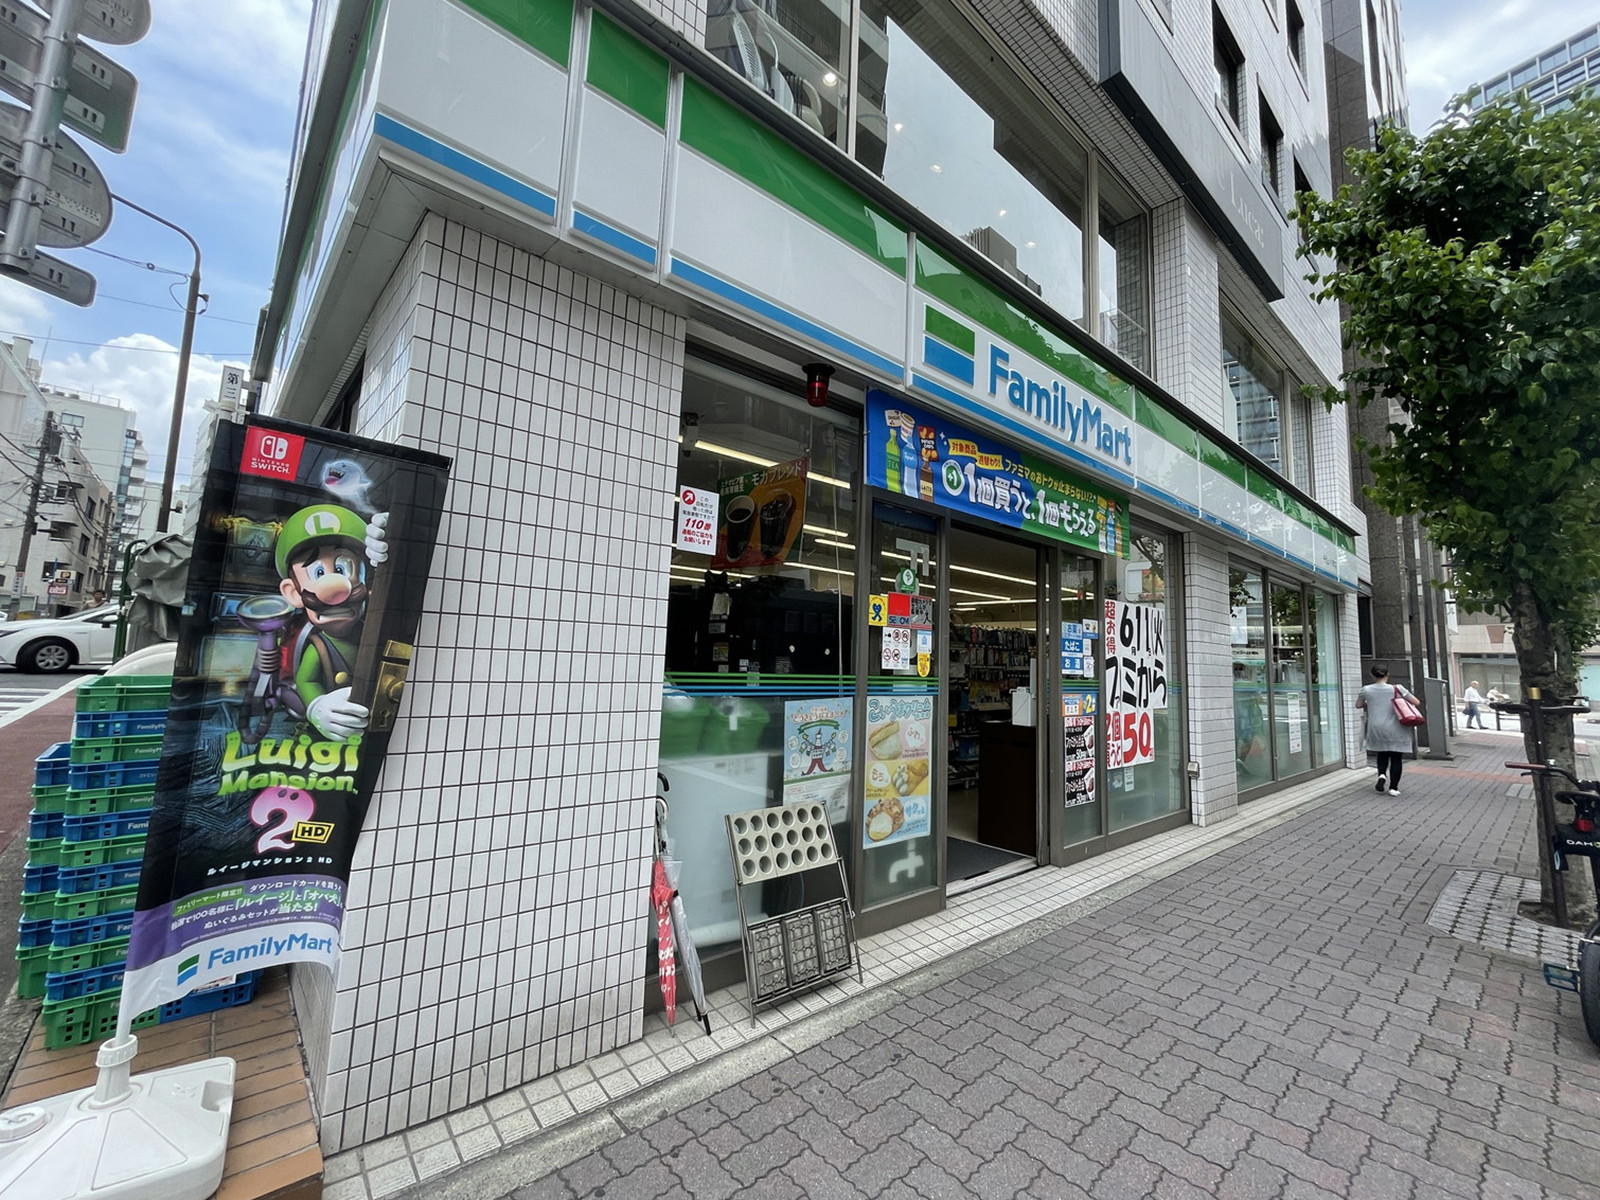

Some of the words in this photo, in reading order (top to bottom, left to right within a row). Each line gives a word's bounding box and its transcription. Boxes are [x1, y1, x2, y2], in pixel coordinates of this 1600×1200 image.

[988, 342, 1132, 465] FamilyMart
[250, 461, 289, 474] SWITCH
[251, 457, 290, 468] NINTENDO
[751, 462, 802, 486] モカブレンド
[887, 460, 900, 469] TEA
[685, 517, 712, 531] 110番
[1105, 601, 1116, 655] 超お得
[1064, 641, 1080, 652] たばこ
[221, 730, 363, 773] Luigi
[217, 770, 355, 796] Mansion
[250, 785, 316, 854] 2
[301, 826, 326, 838] HD
[207, 856, 313, 876] ルイージマンション2
[318, 856, 333, 864] HD
[250, 880, 342, 893] ダウンロードカードを買うと
[177, 889, 243, 913] ファミリーマート限定!!
[203, 903, 318, 930] ぬいぐるみセットが当たる!
[207, 933, 332, 969] FamilyMart
